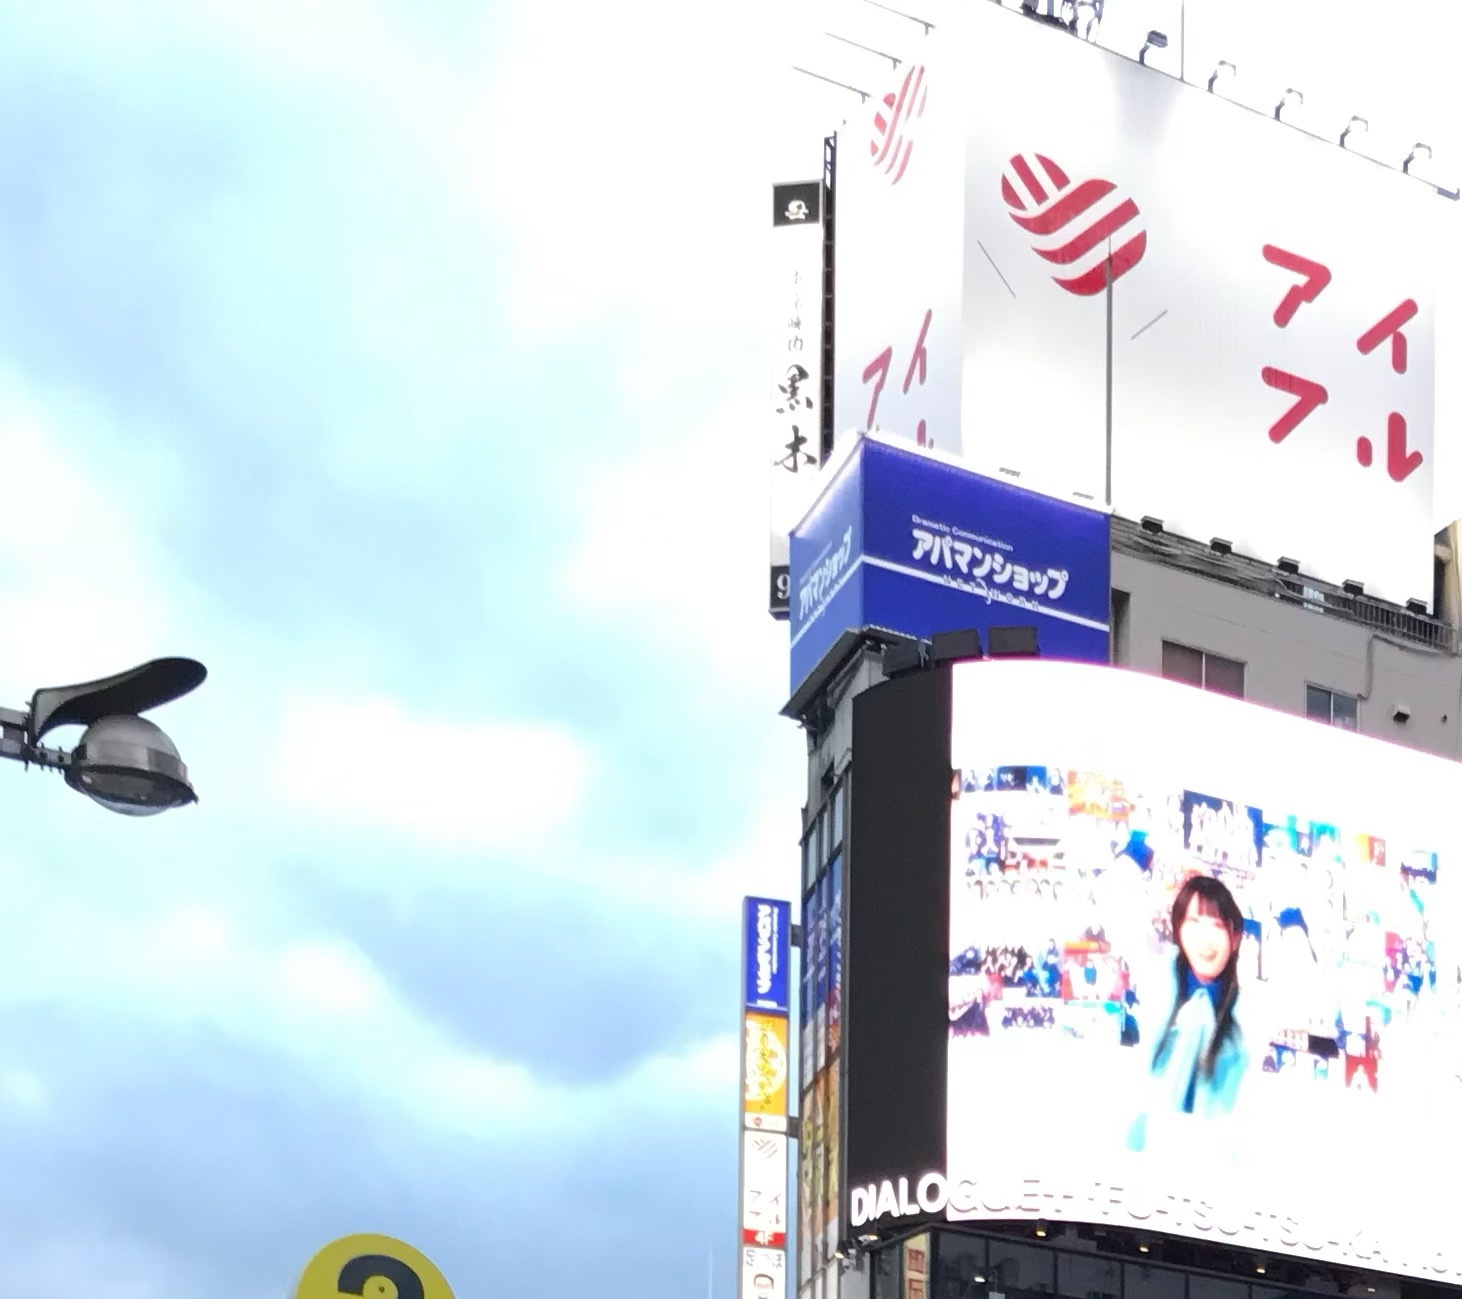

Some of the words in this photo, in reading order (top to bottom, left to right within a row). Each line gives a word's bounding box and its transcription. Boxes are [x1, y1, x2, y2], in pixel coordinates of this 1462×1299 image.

[912, 528, 1069, 600] アパマンショップ
